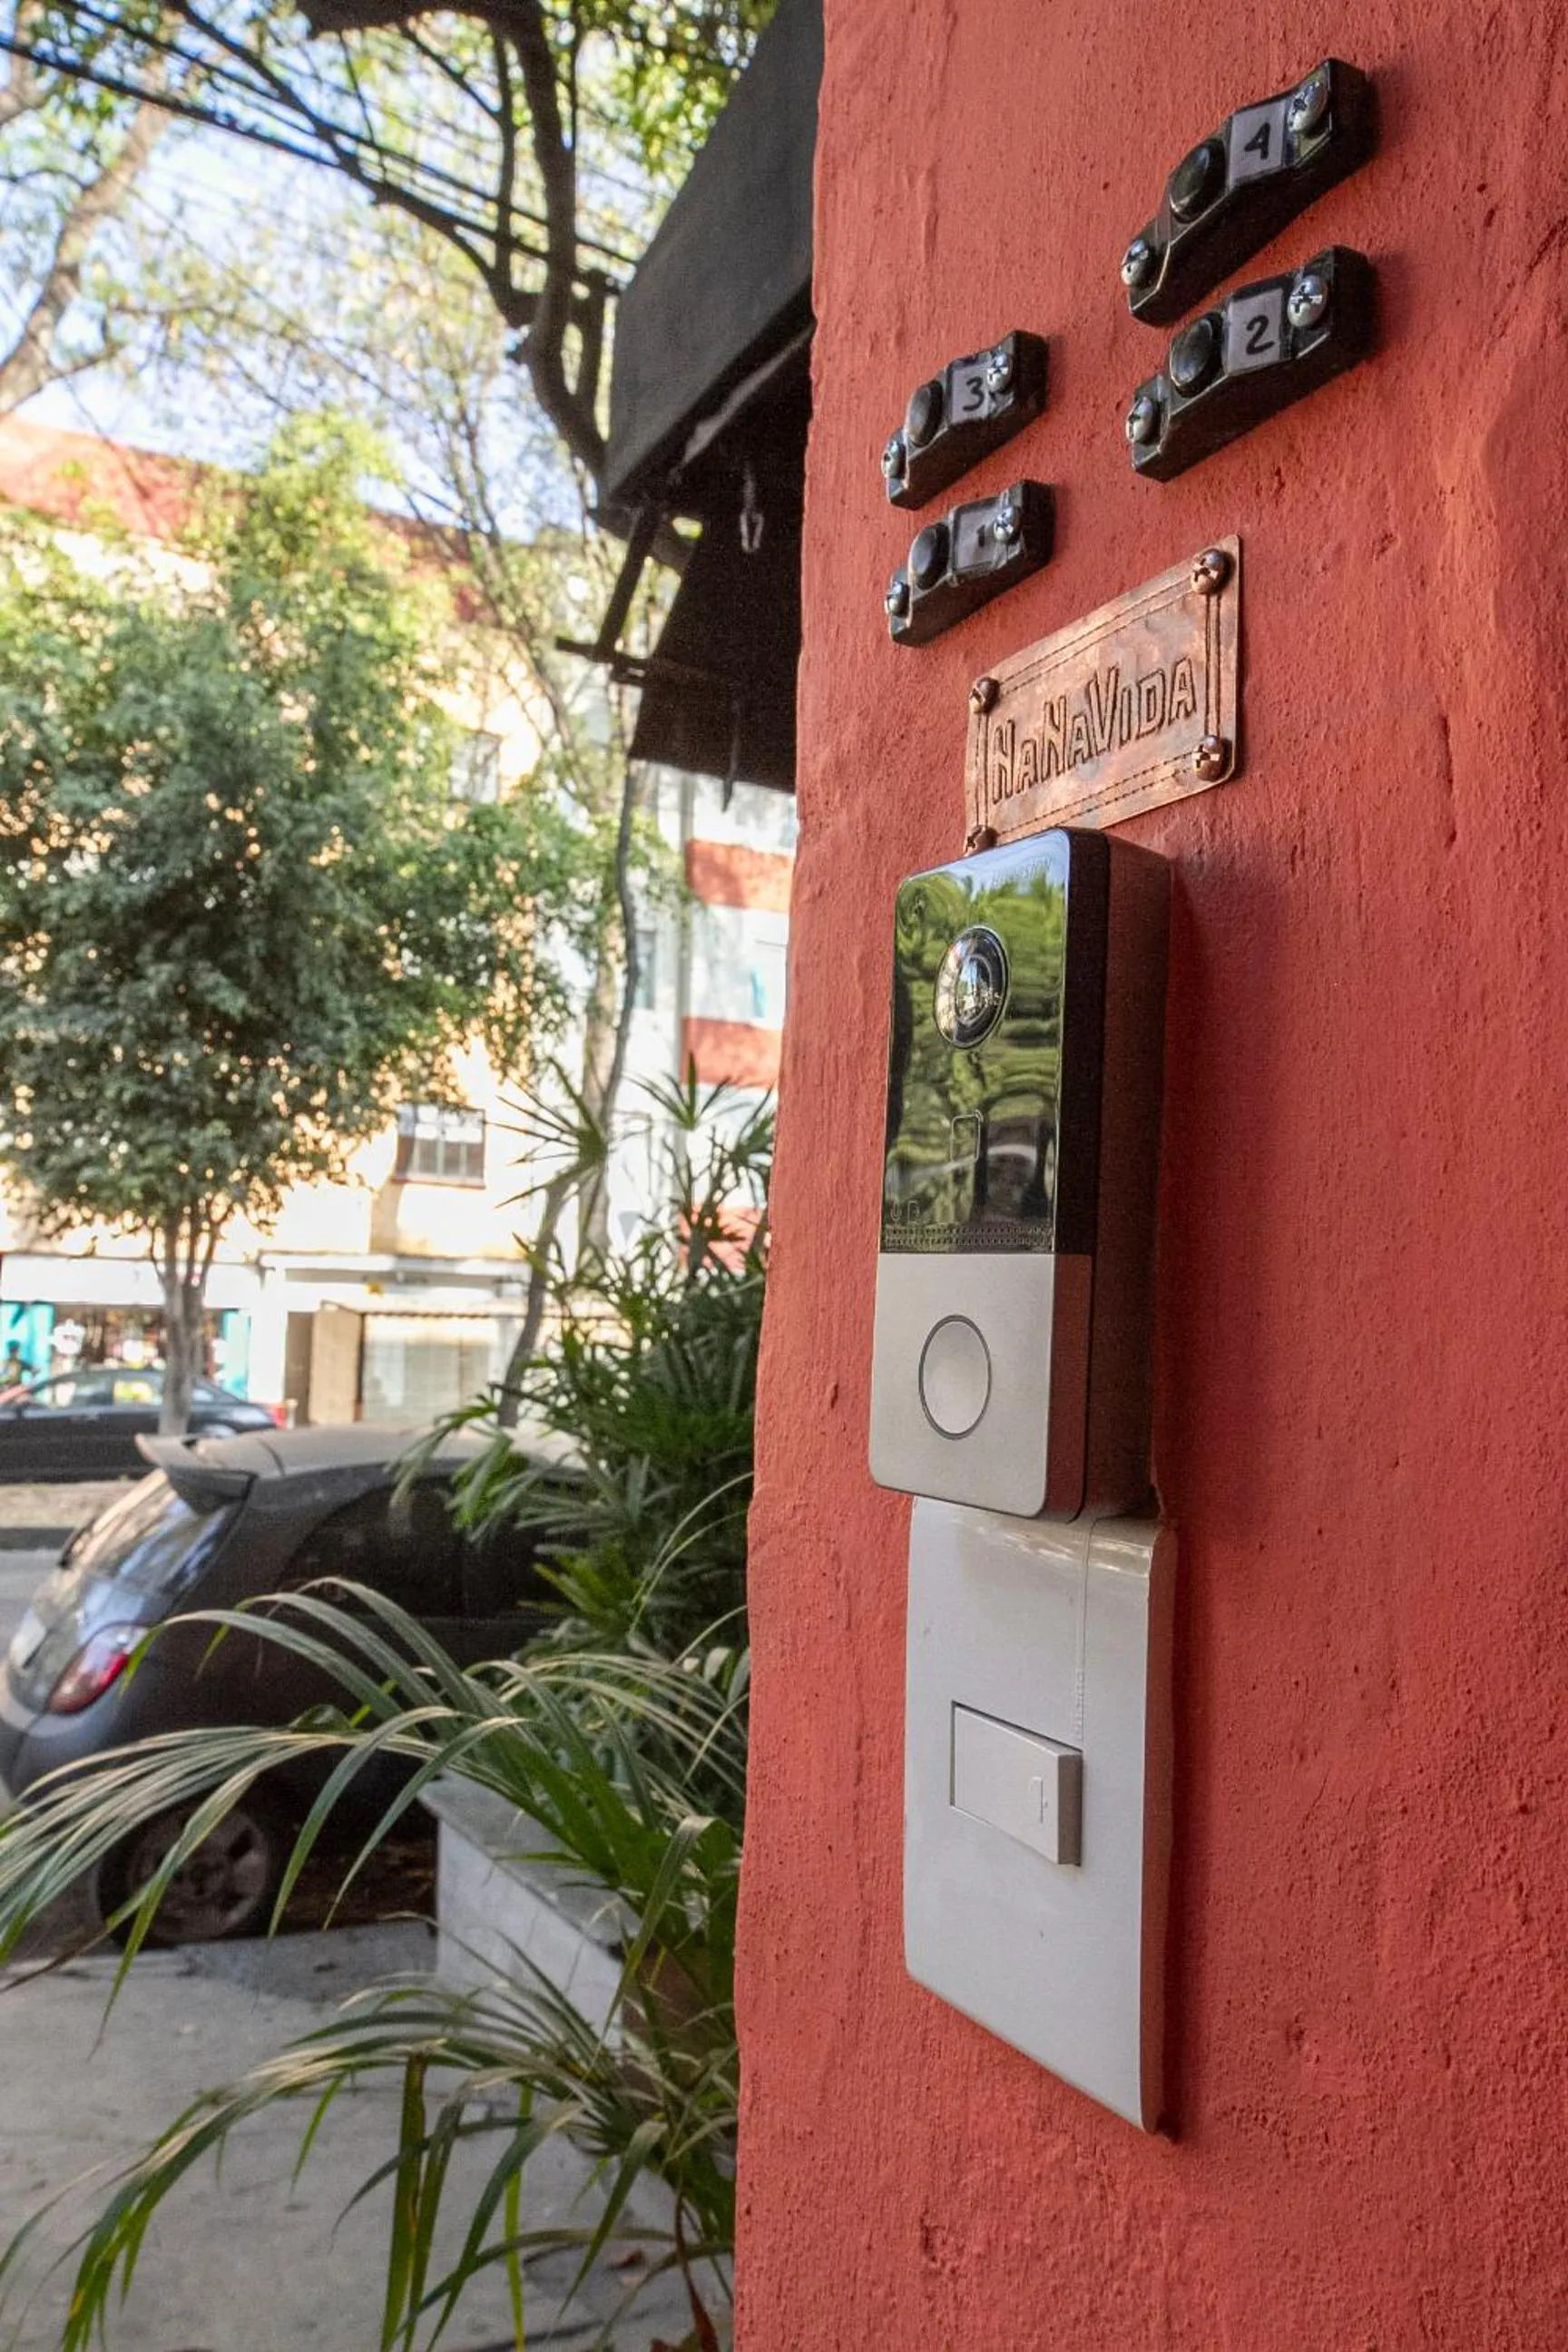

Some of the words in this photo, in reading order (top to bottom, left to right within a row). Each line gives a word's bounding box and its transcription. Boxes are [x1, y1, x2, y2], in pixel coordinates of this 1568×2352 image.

[1244, 122, 1270, 160] 4
[1246, 315, 1274, 356] 2
[963, 377, 985, 411] 3
[976, 524, 985, 547] 1
